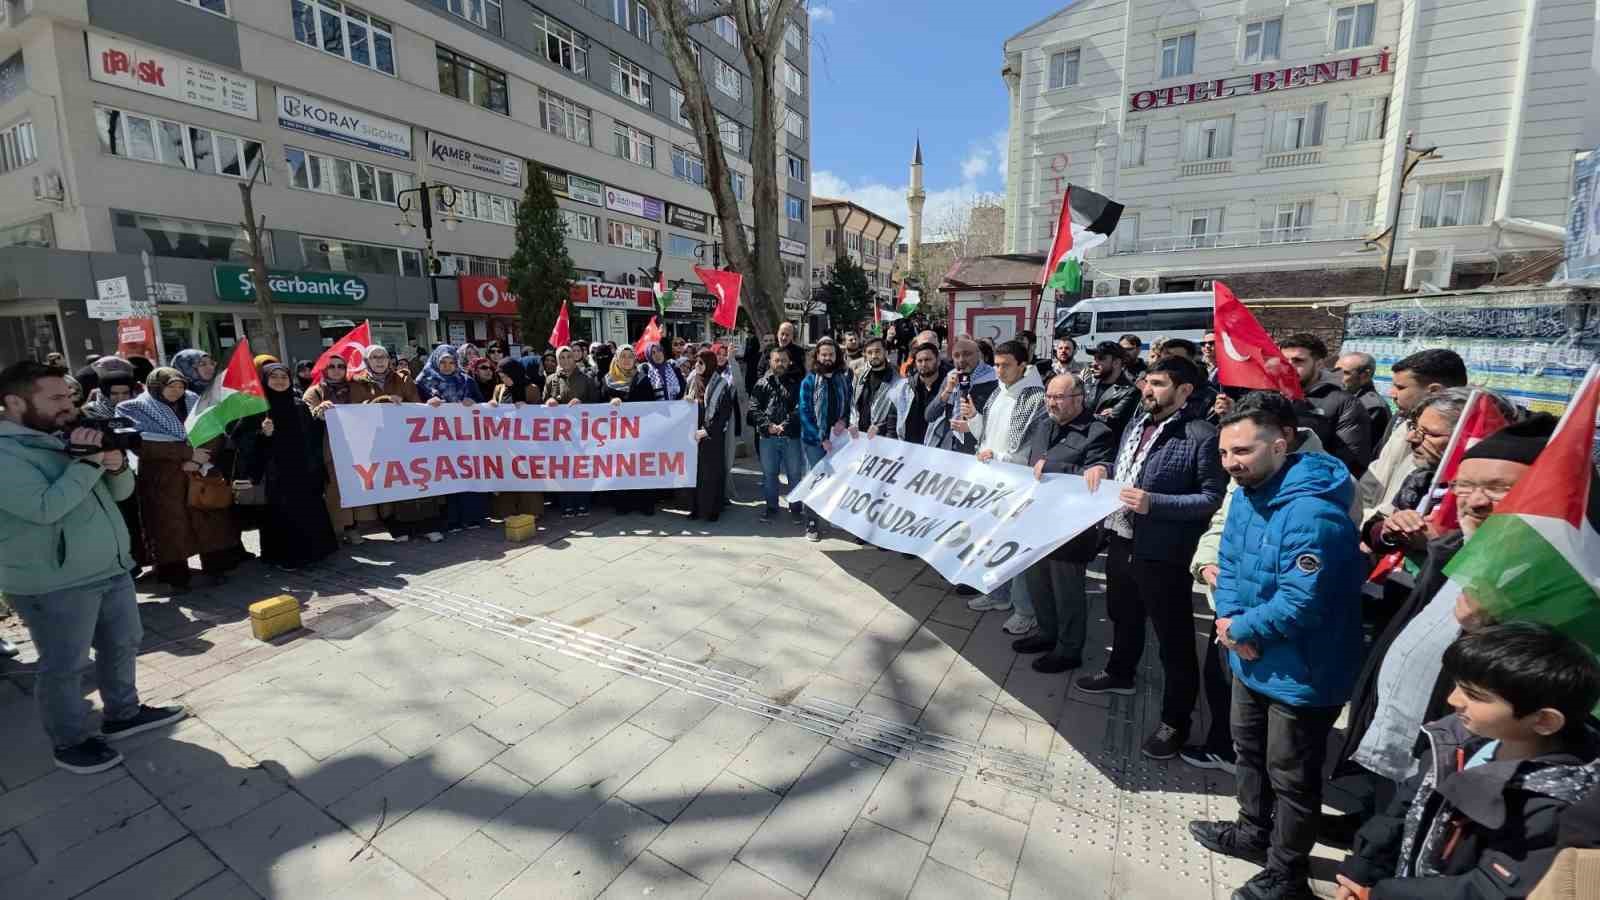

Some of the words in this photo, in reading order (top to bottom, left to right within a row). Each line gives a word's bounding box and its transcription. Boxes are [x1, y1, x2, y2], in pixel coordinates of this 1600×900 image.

[1131, 79, 1234, 112] OTEL
[1253, 46, 1391, 92] BENLİ
[303, 104, 360, 132] KORAY
[431, 140, 472, 162] KAMER
[238, 273, 341, 296] Şkerbank
[591, 284, 636, 300] ECZANE
[406, 410, 572, 443] ZALİMLER
[581, 411, 640, 448] İÇİN
[352, 455, 504, 492] YAŞASIN
[512, 452, 686, 480] CEHENNEM
